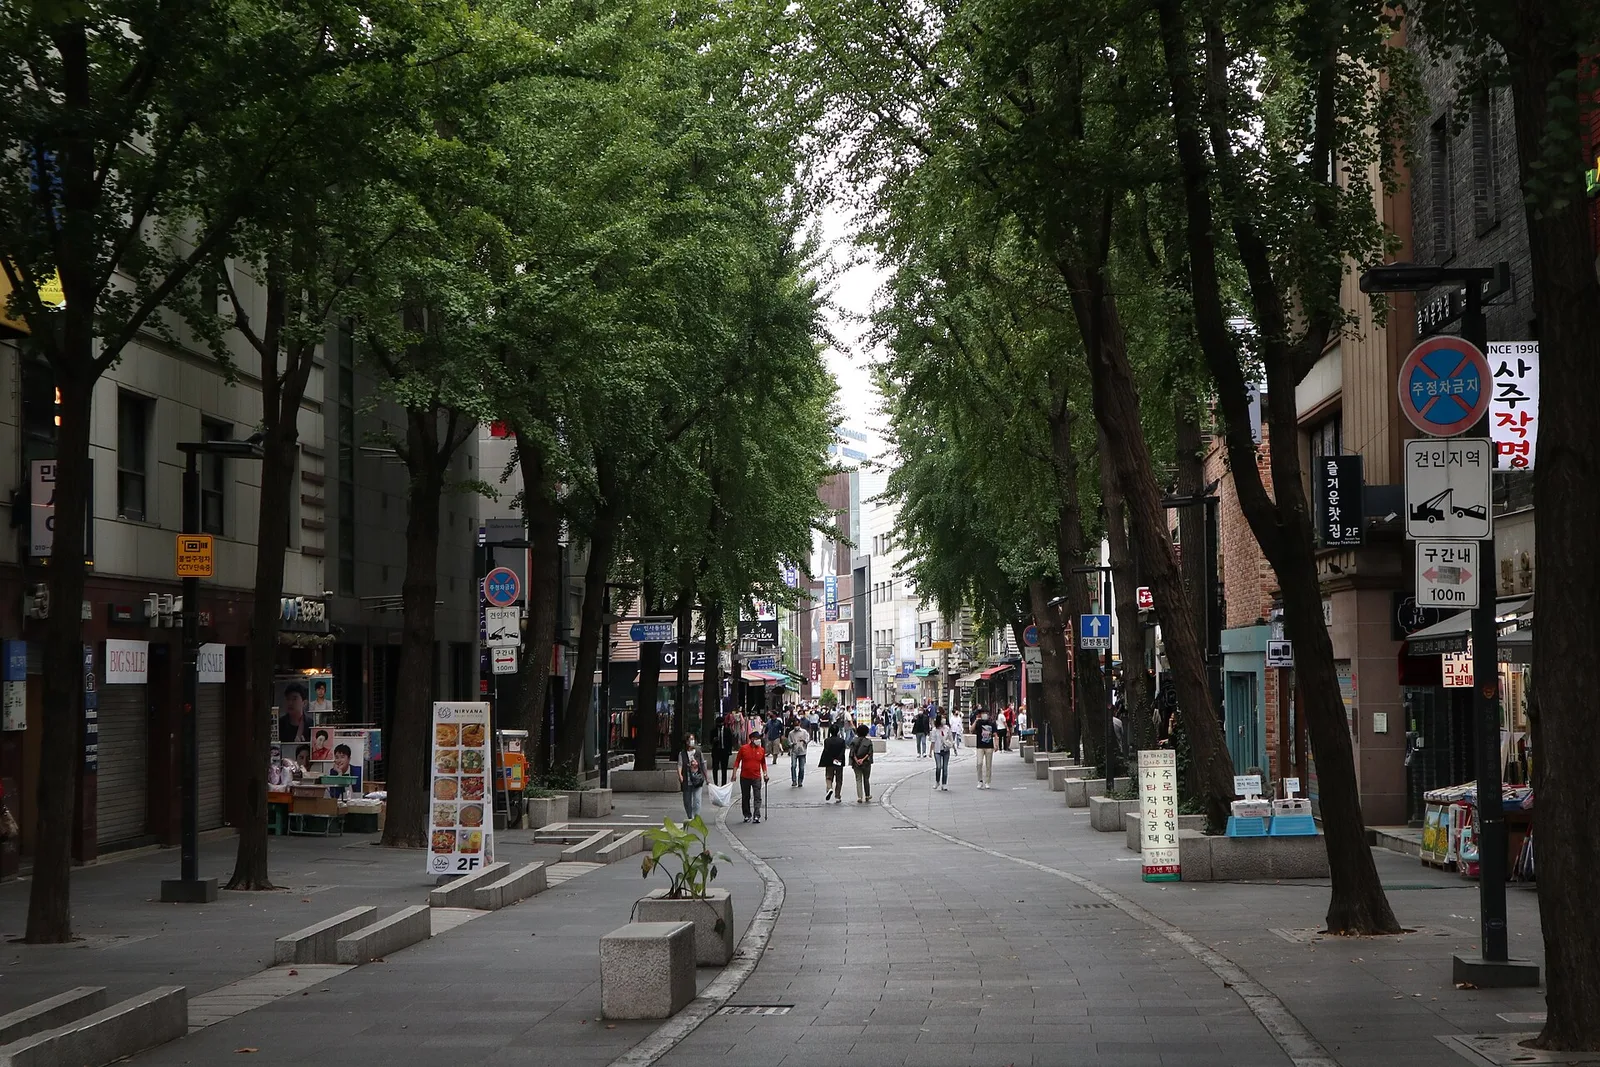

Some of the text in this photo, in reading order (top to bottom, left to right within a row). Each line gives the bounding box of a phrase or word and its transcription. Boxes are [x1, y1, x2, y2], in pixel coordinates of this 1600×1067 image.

[1487, 344, 1512, 354] INCE
[1412, 378, 1479, 397] 주정차금지
[1415, 449, 1479, 468] 견인지역
[1326, 461, 1341, 539] 즐거운찻집
[1345, 527, 1359, 537] 2F
[1425, 547, 1471, 563] 구간내
[489, 583, 515, 591] 주정차금지
[1430, 588, 1466, 602] 100m
[489, 611, 516, 619] 견인지역
[1082, 638, 1109, 646] 일방통행
[110, 650, 146, 673] BIG SALE
[208, 653, 224, 673] SALE
[457, 858, 480, 870] 2F
